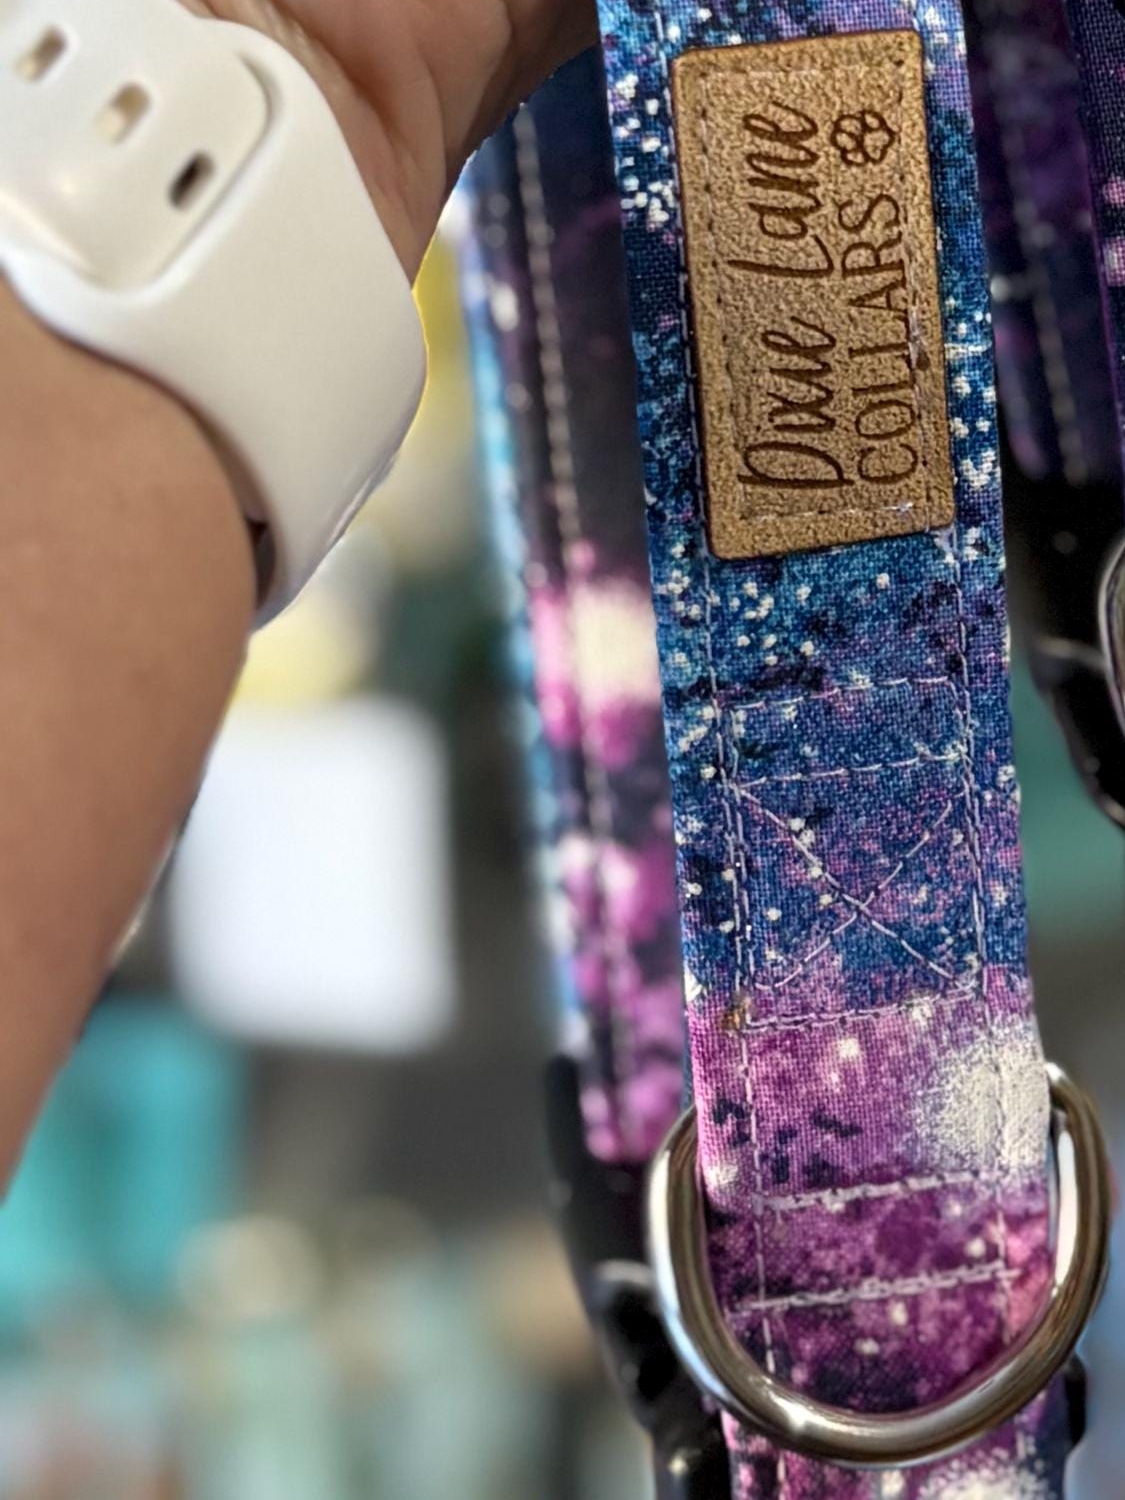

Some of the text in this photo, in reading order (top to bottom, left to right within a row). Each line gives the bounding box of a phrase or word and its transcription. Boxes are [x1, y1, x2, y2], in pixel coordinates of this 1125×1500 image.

[728, 101, 854, 489] Dixie Lane
[837, 192, 919, 484] COLLARS
